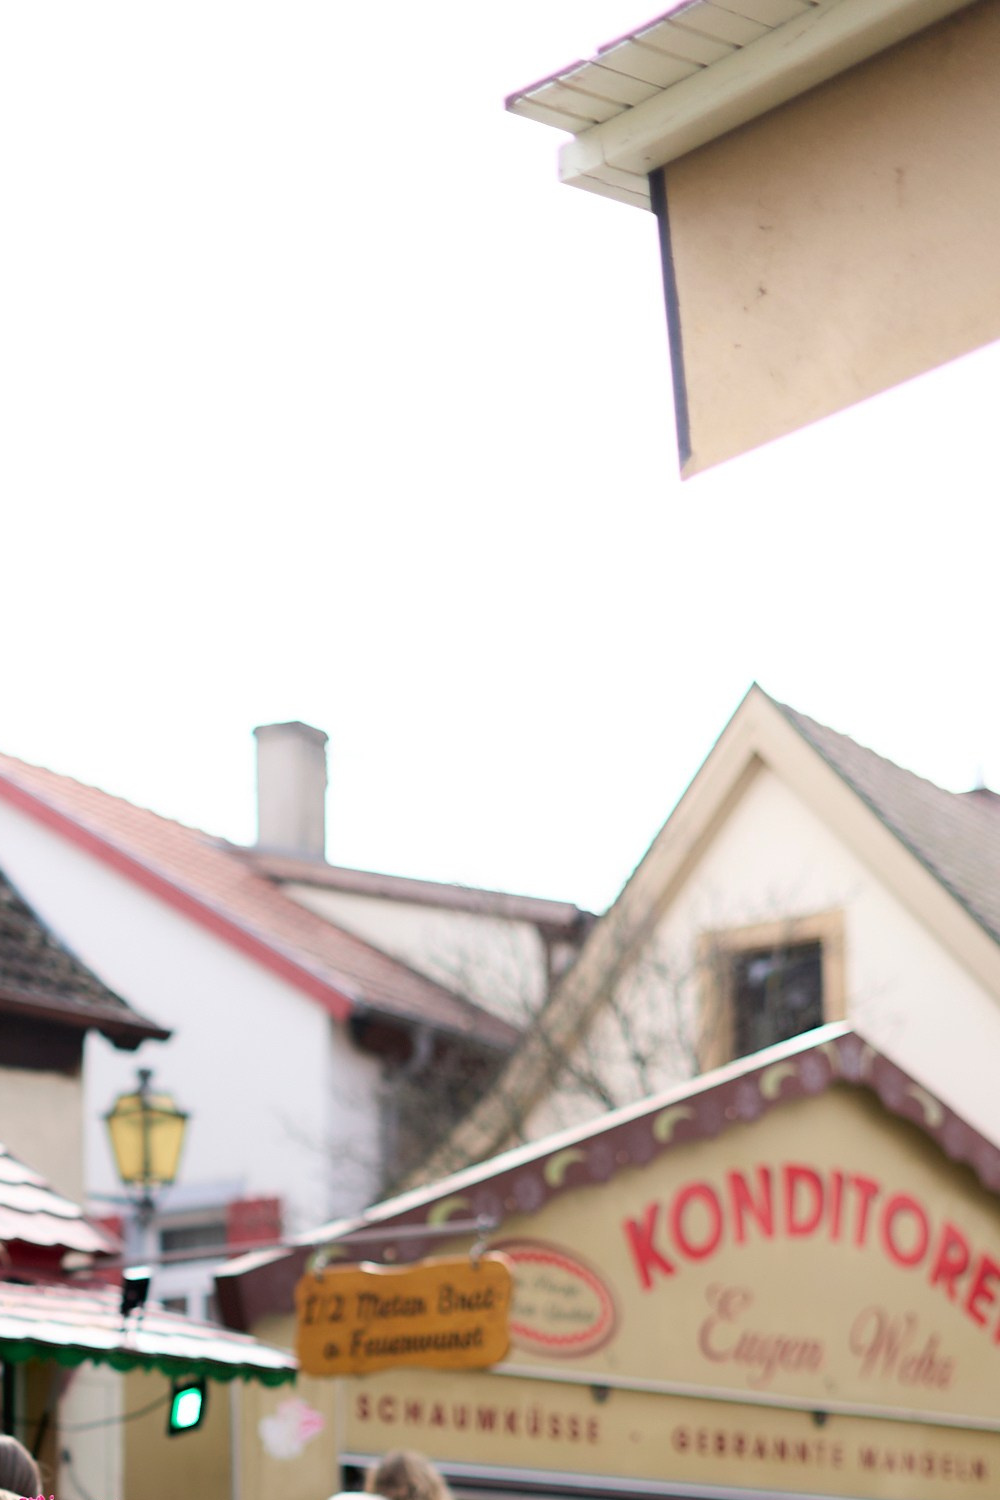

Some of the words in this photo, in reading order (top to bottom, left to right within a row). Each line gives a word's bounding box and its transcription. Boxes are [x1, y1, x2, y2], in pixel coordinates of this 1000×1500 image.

[624, 1163, 1000, 1348] KONDITORE
[356, 1393, 600, 1444] SCHAUMKÜSSE
[670, 1424, 844, 1470] GEBRANNTE
